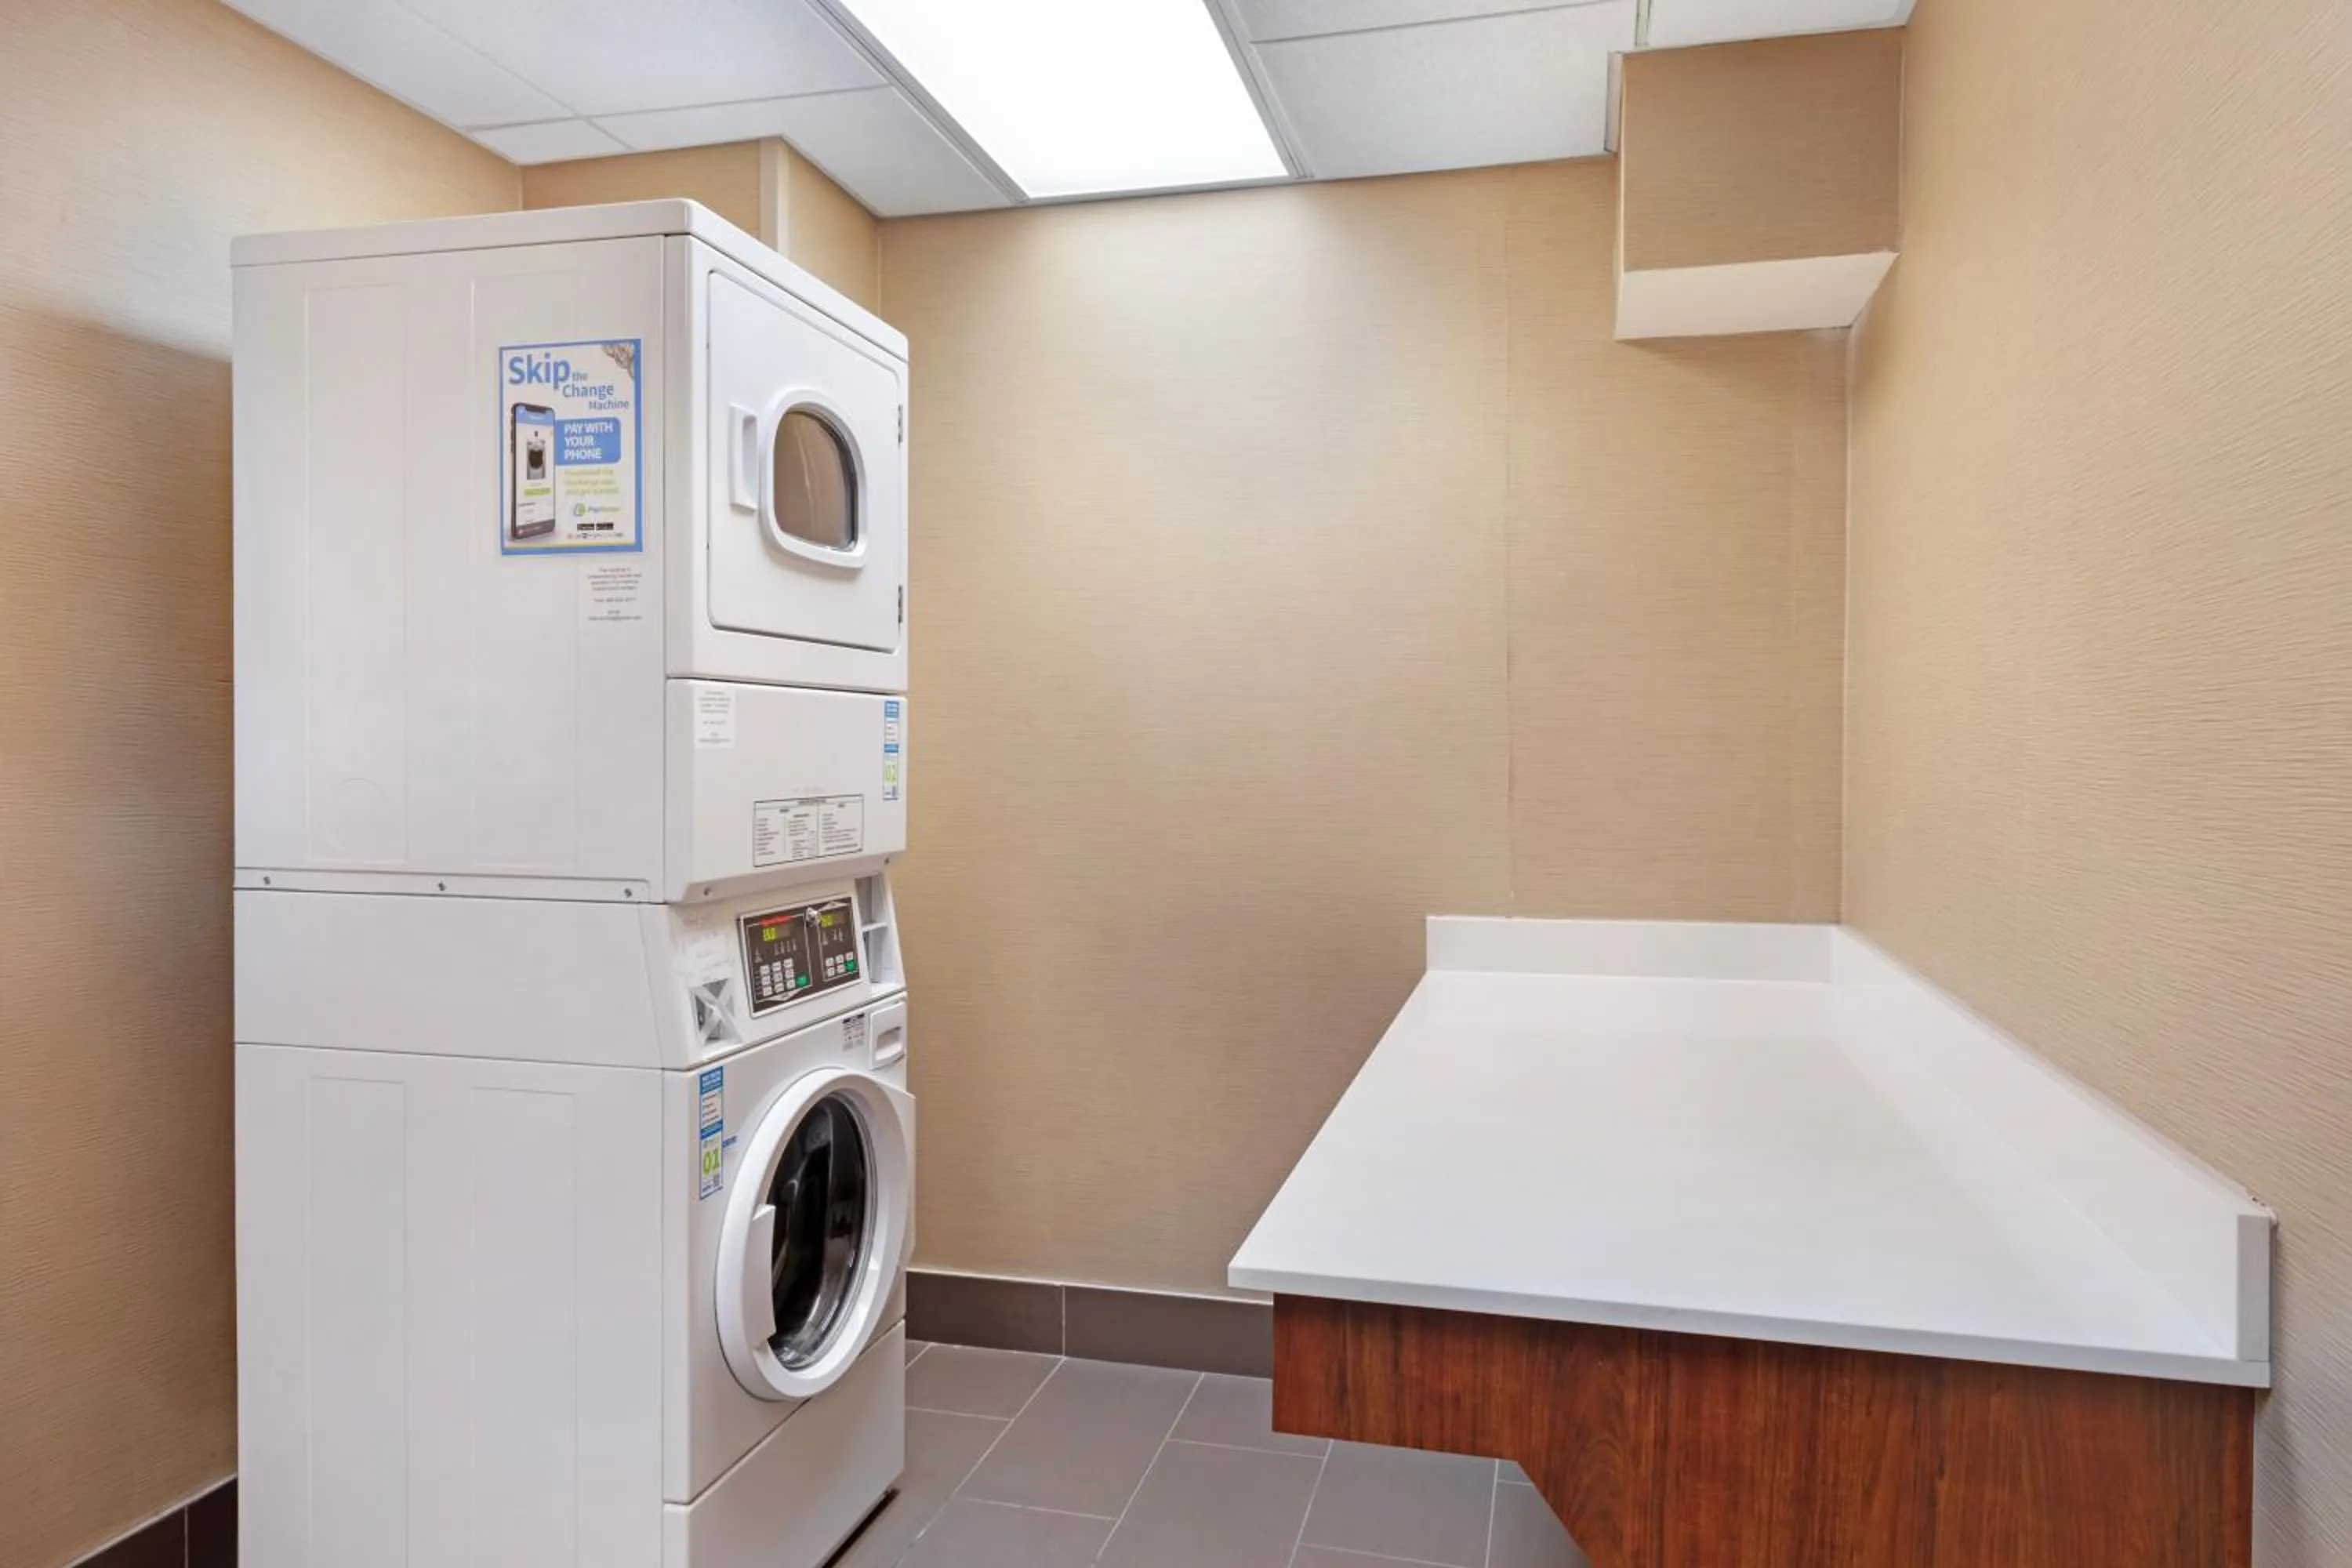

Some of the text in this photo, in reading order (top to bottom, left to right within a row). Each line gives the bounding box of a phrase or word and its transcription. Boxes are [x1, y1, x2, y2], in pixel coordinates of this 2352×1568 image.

[508, 352, 588, 390] Skip the
[562, 384, 614, 399] Change
[589, 400, 630, 410] Machine
[564, 421, 614, 435] PAY WITH
[564, 434, 595, 447] YOUR
[564, 448, 602, 460] PHONE
[702, 1147, 720, 1175] 01
